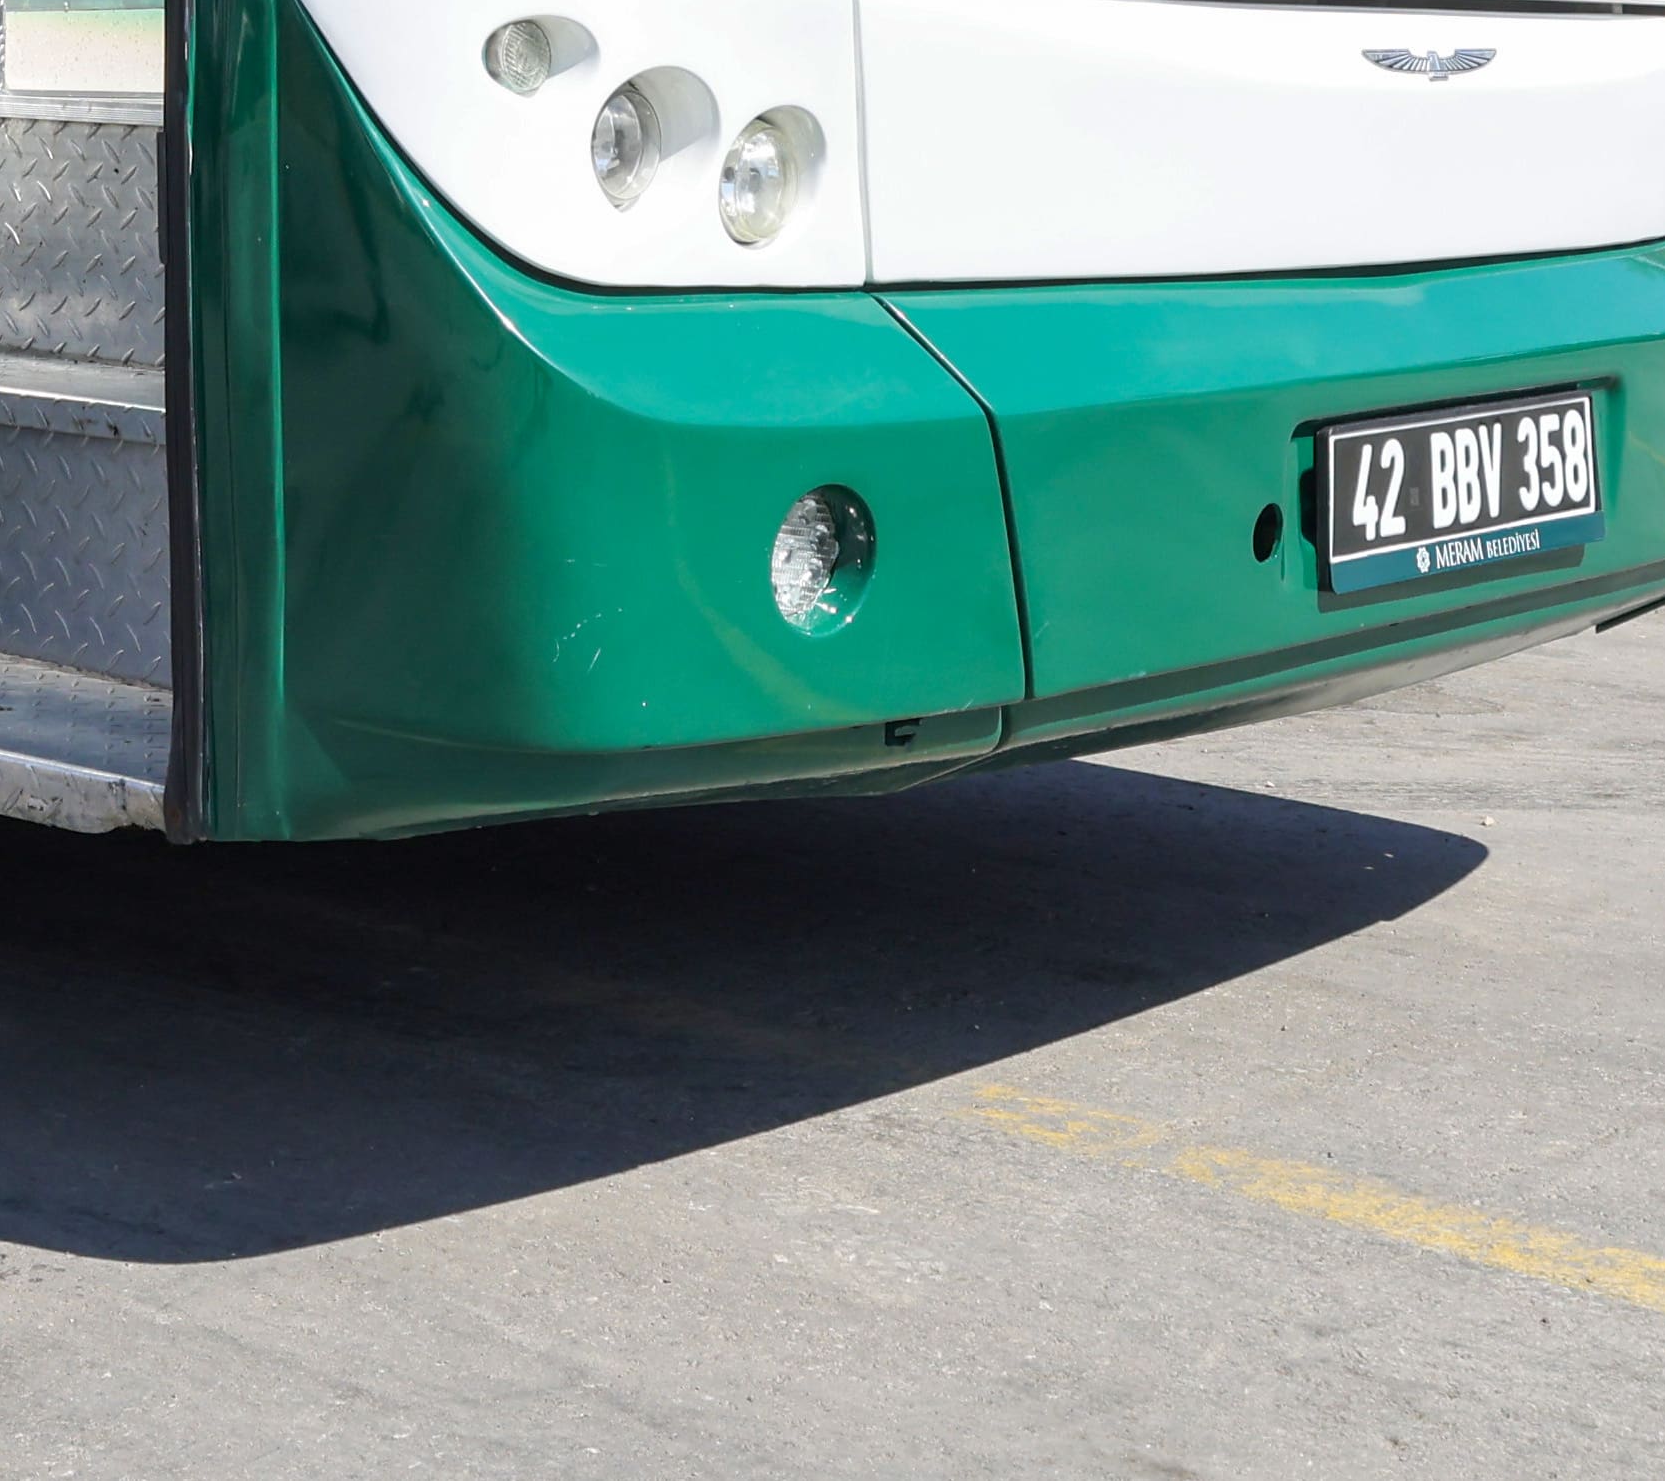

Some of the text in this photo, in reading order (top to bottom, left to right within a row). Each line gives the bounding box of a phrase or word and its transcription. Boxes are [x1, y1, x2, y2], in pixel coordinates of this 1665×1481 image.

[1352, 408, 1589, 542] 42 BBV 358
[1435, 527, 1542, 570] MERAM BELEDİYESİ
